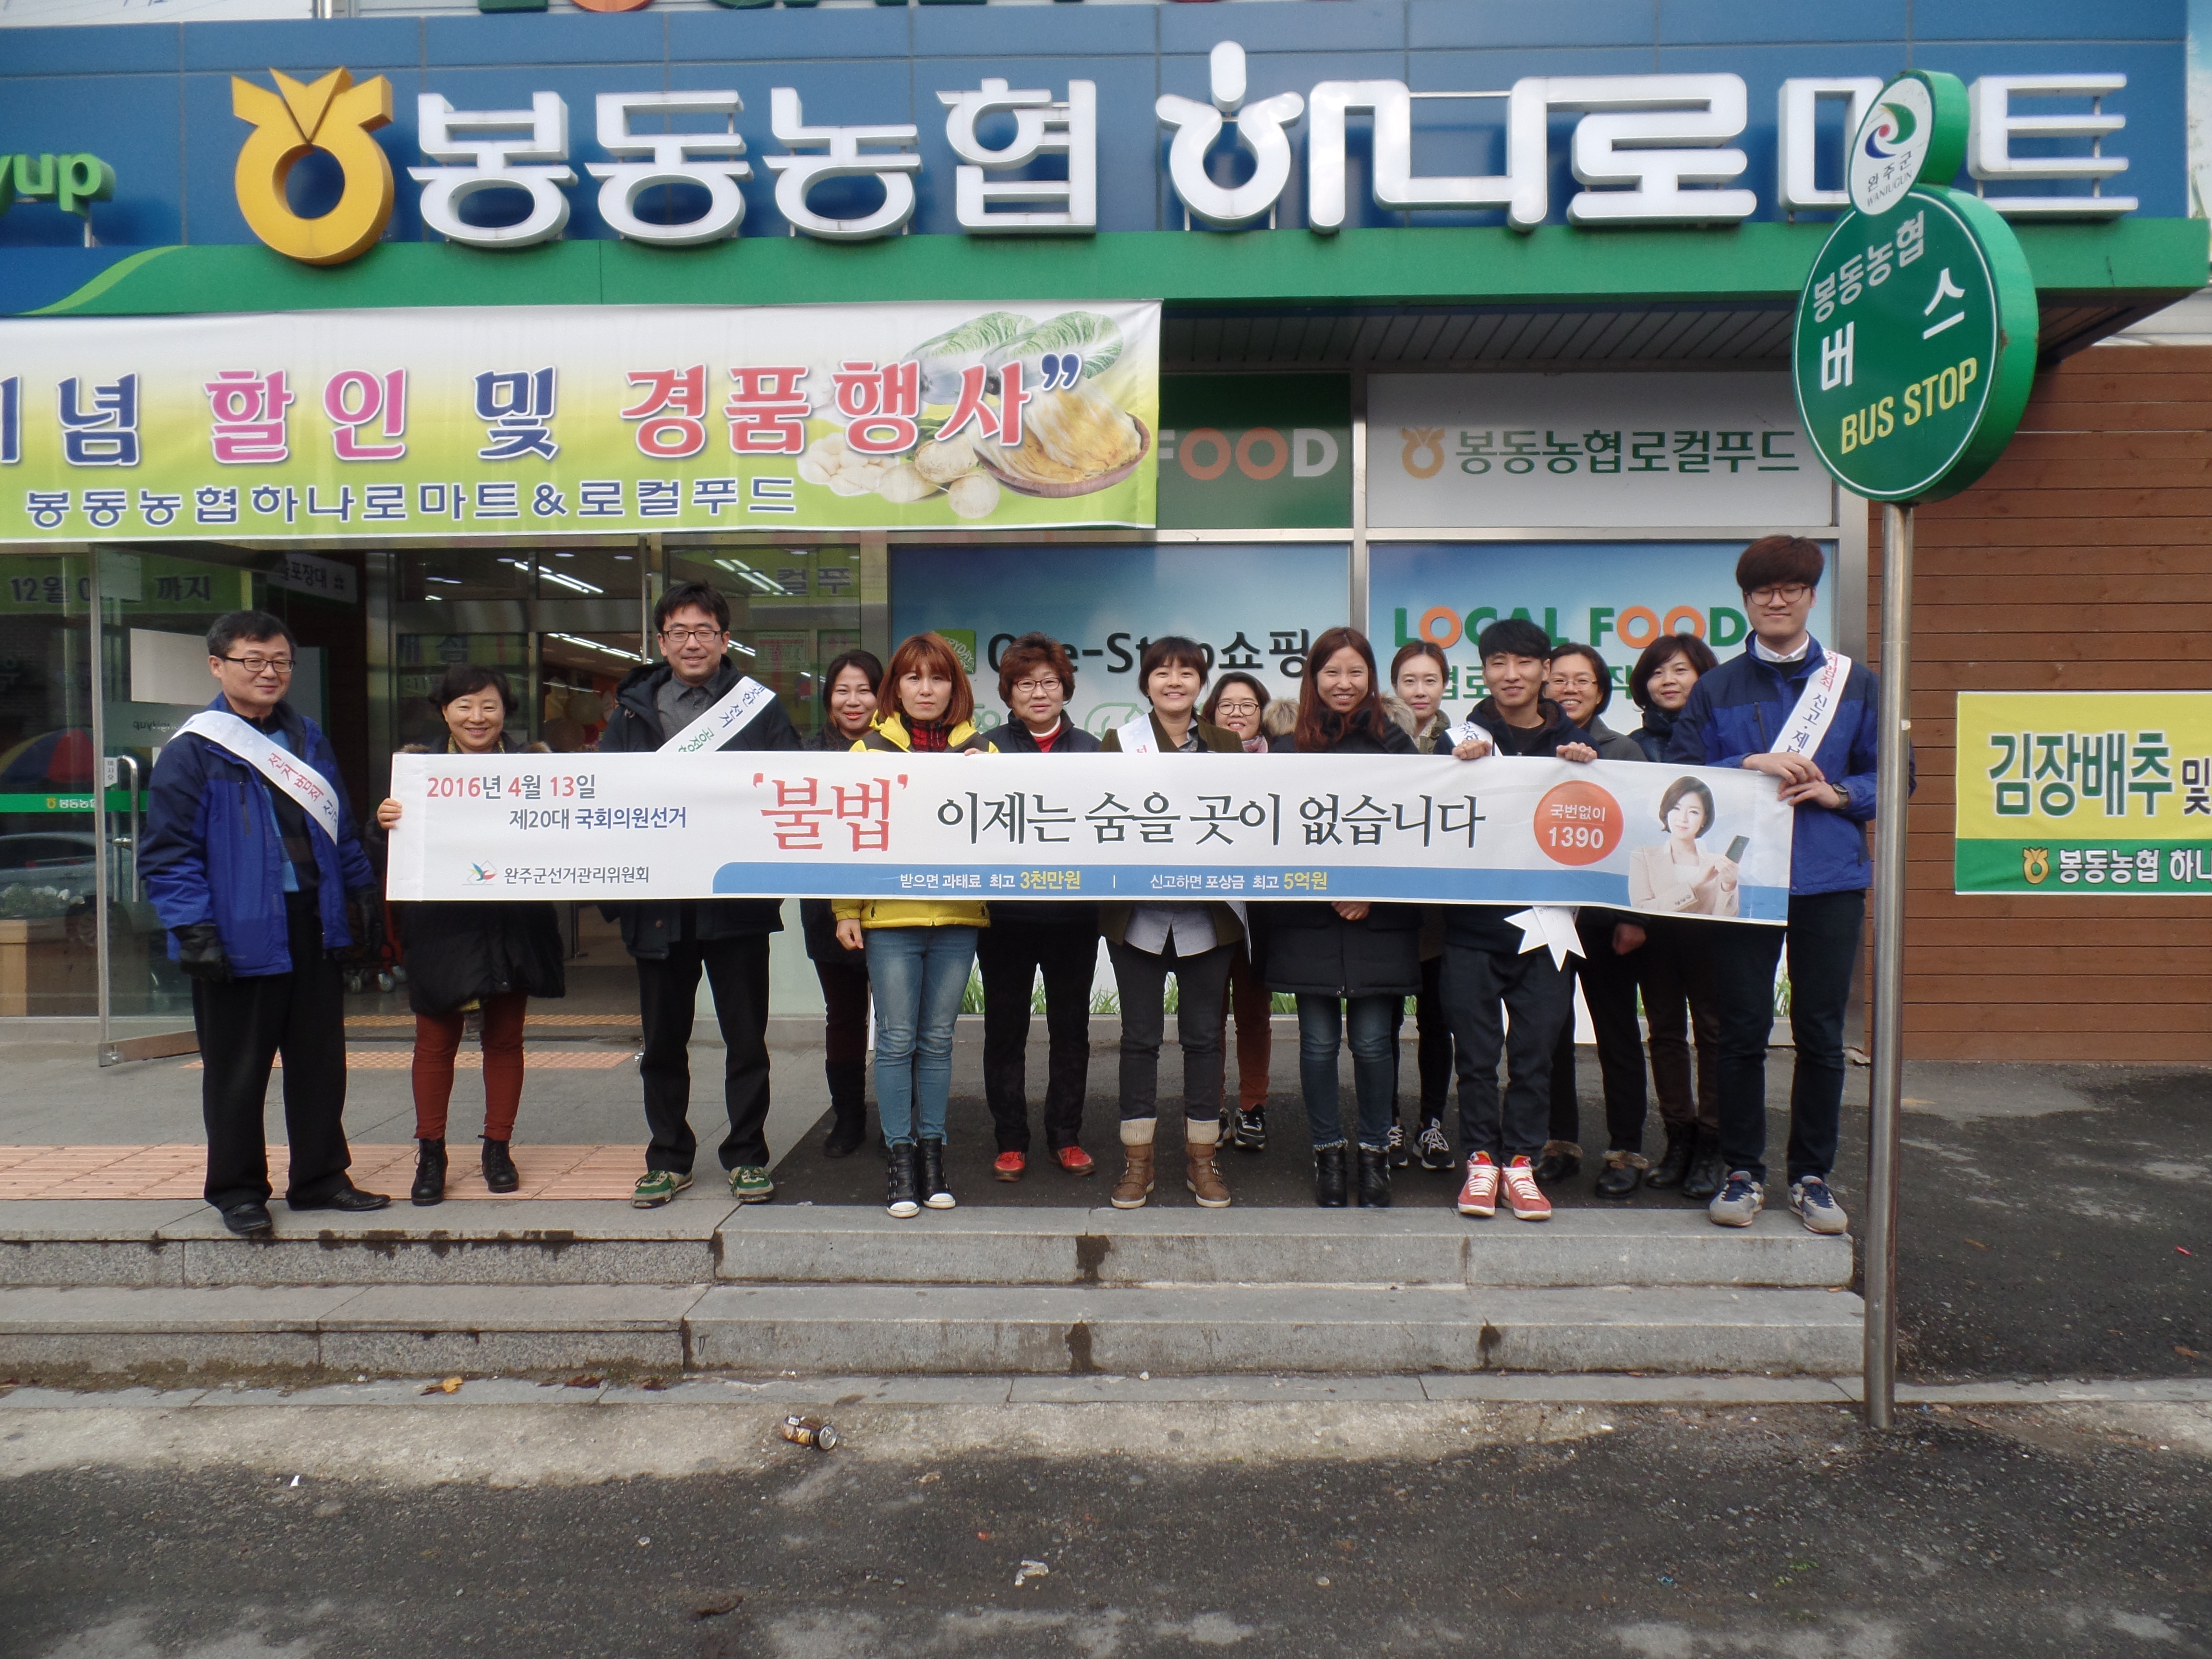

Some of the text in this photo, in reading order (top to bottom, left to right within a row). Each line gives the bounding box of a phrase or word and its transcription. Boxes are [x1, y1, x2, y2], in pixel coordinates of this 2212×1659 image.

[407, 78, 1097, 248] 봉동농협
[1868, 150, 1912, 192] 완주군
[1814, 210, 1924, 324] 봉동농협
[205, 369, 406, 462] 할인
[473, 367, 557, 459] 및
[1841, 357, 1977, 455] BUS STOP
[1456, 430, 1800, 474] 봉동농협로컬푸드
[1590, 605, 1747, 649] FOOD
[1820, 650, 1839, 692] 거범죄
[718, 704, 744, 729] 선거
[268, 752, 325, 802] 선거범죄
[427, 774, 596, 799] 2016년 4월 13일
[1989, 733, 2212, 816] 김장배추 및
[509, 806, 687, 830] 제20대 국회의원선거
[937, 791, 1076, 845] 이제는
[1084, 791, 1181, 844] 숨을
[1189, 793, 1281, 846] 곳이
[1299, 793, 1486, 849] 없습니다
[1550, 804, 1606, 822] 국번없이
[1549, 826, 1605, 849] 1390
[504, 866, 649, 885] 완주군선거관리위원회
[900, 870, 1081, 890] 받으면 과태료 최고 3천만원
[1150, 871, 1328, 891] 신고하면 포상금 최고 5억원
[2059, 849, 2160, 884] 봉동농협
